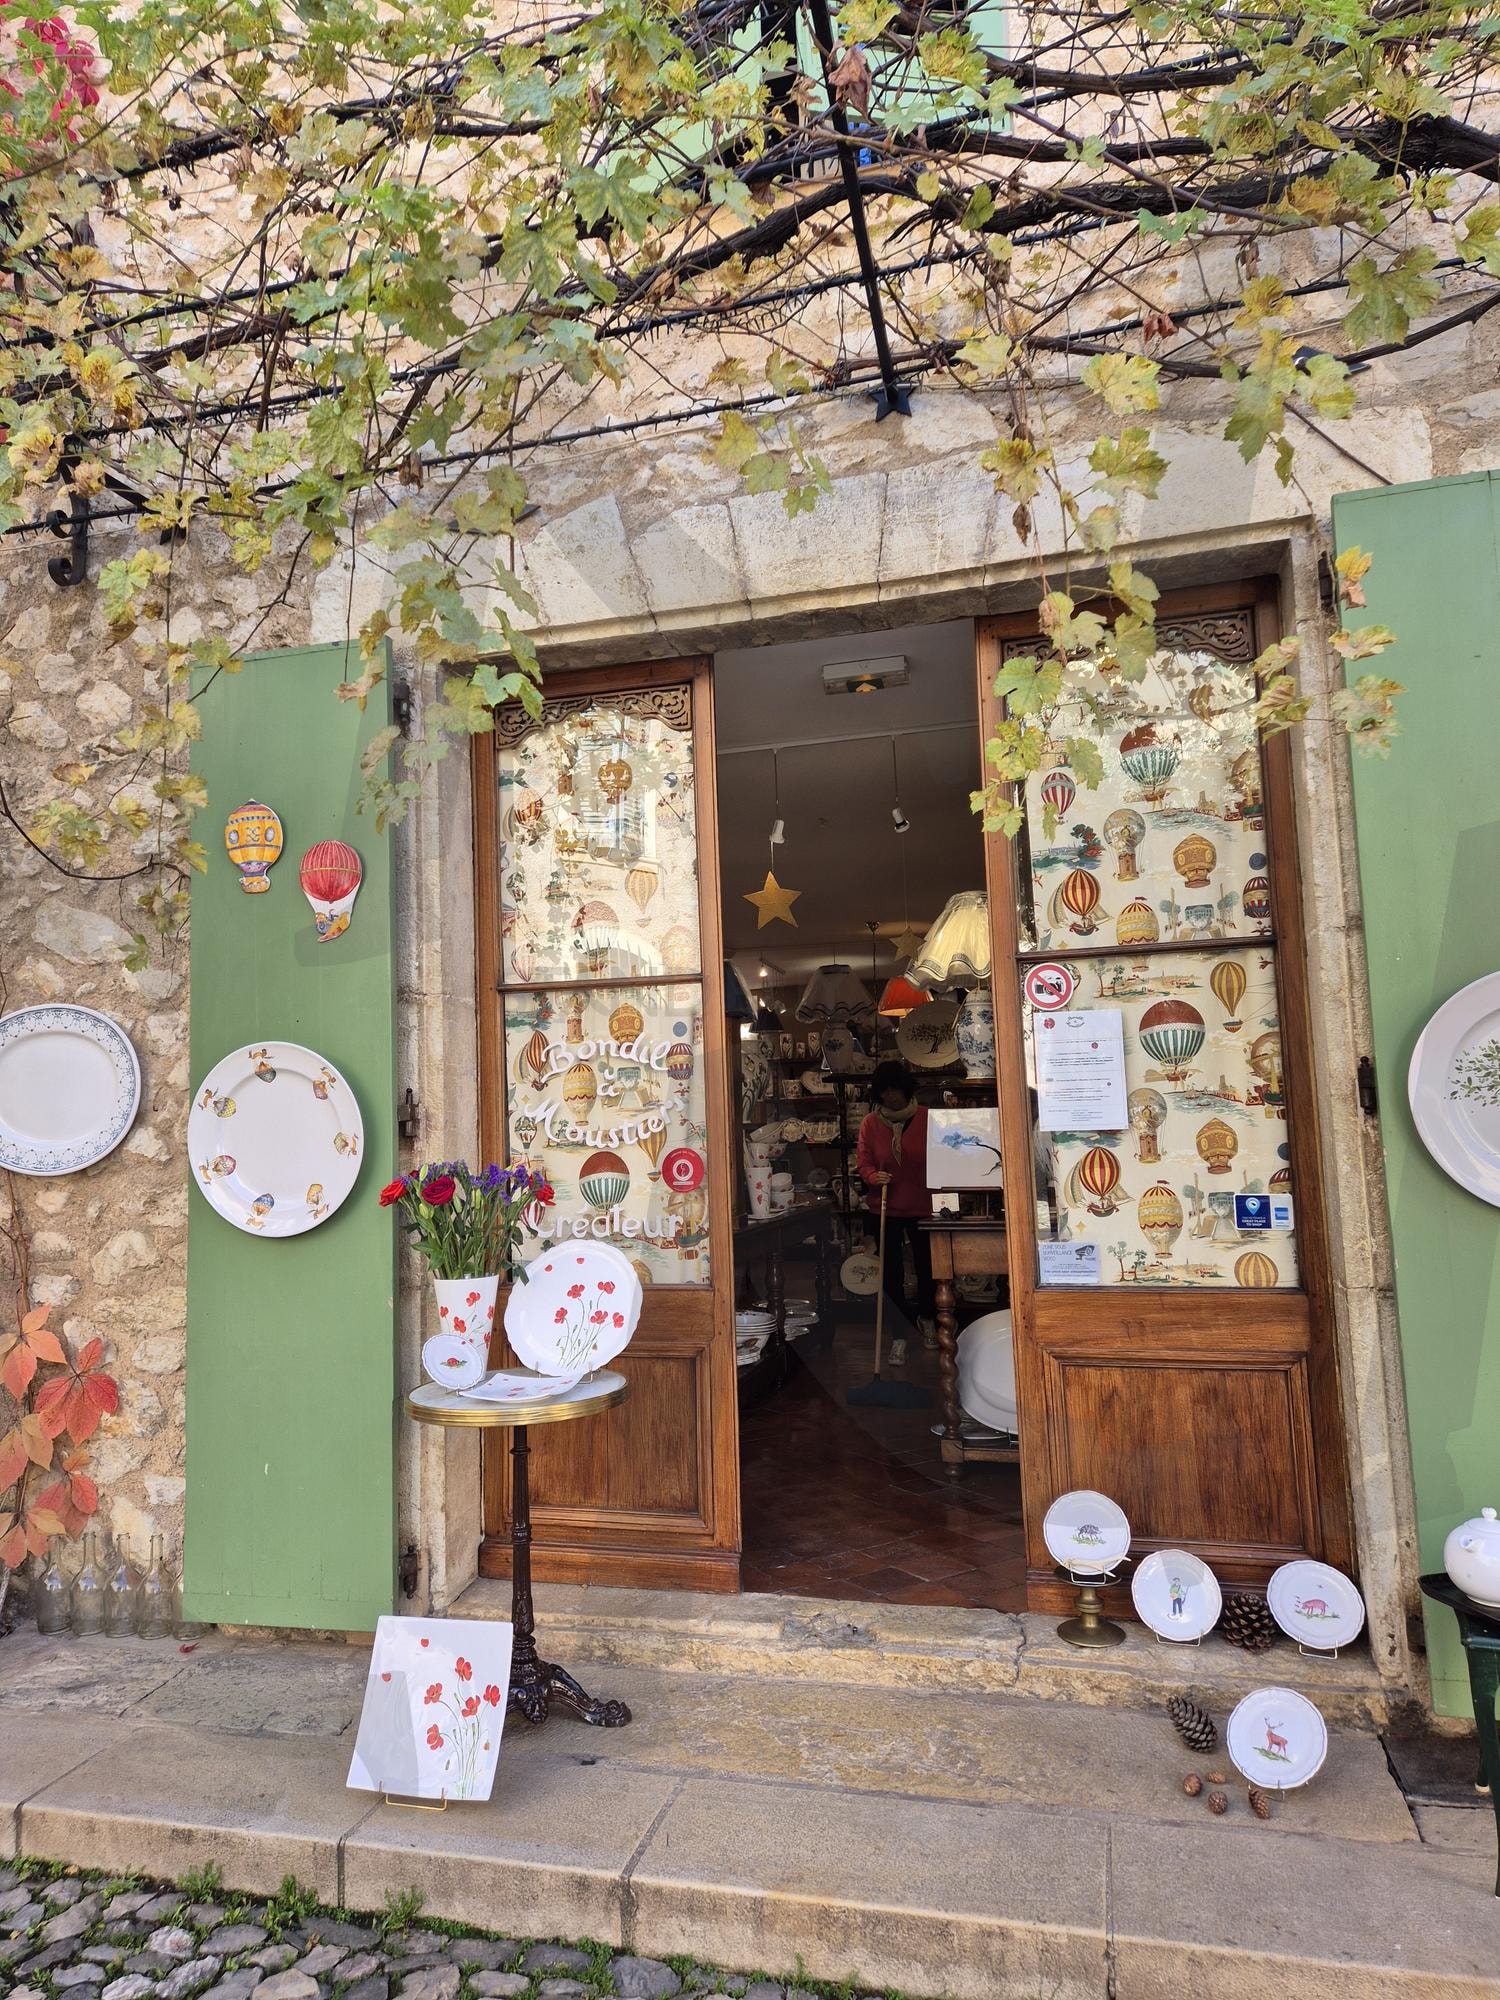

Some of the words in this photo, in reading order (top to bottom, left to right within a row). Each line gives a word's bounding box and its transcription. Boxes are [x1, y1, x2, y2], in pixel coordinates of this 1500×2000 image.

[540, 1031, 672, 1084] Bondil
[597, 1068, 620, 1096] à
[525, 1097, 687, 1149] Moustiers
[528, 1203, 684, 1239] Créateur
